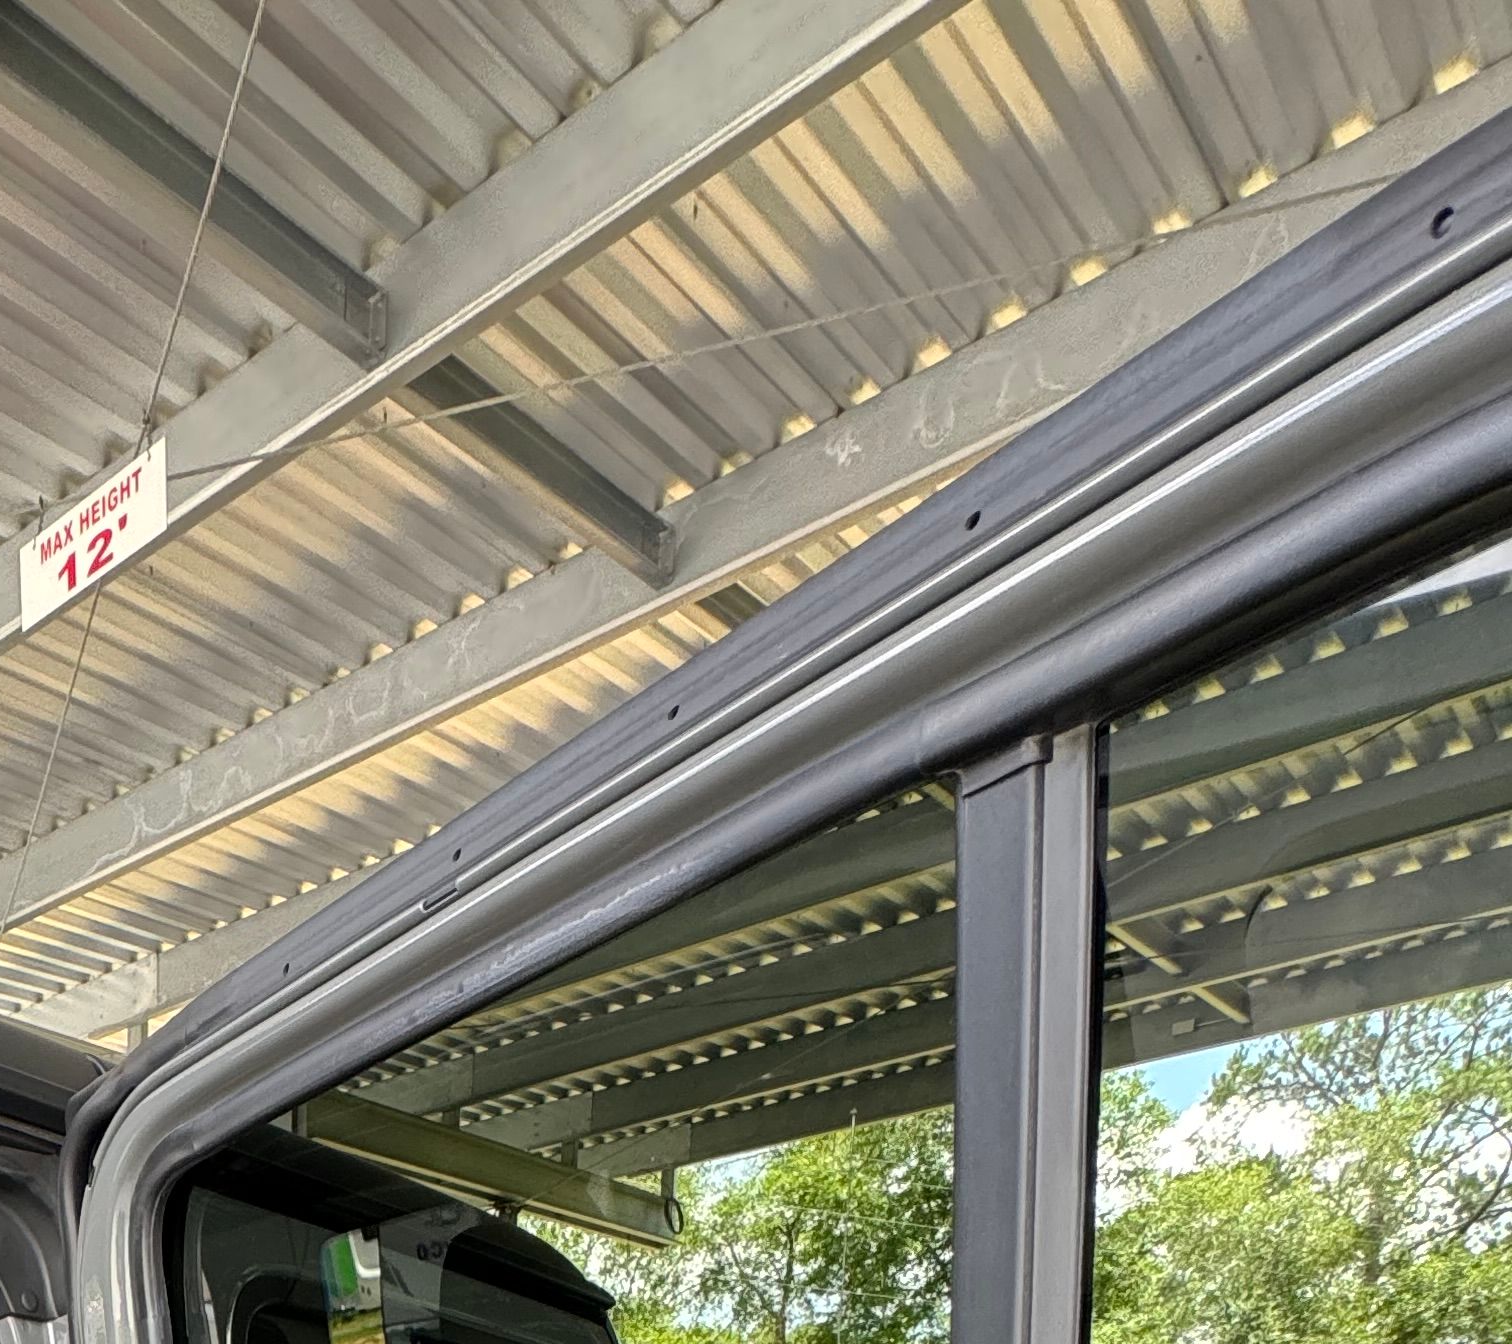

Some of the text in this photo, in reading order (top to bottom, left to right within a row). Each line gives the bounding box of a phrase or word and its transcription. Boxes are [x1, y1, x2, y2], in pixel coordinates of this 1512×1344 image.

[40, 466, 143, 566] MAX HEIGHT
[57, 512, 128, 592] 12'
